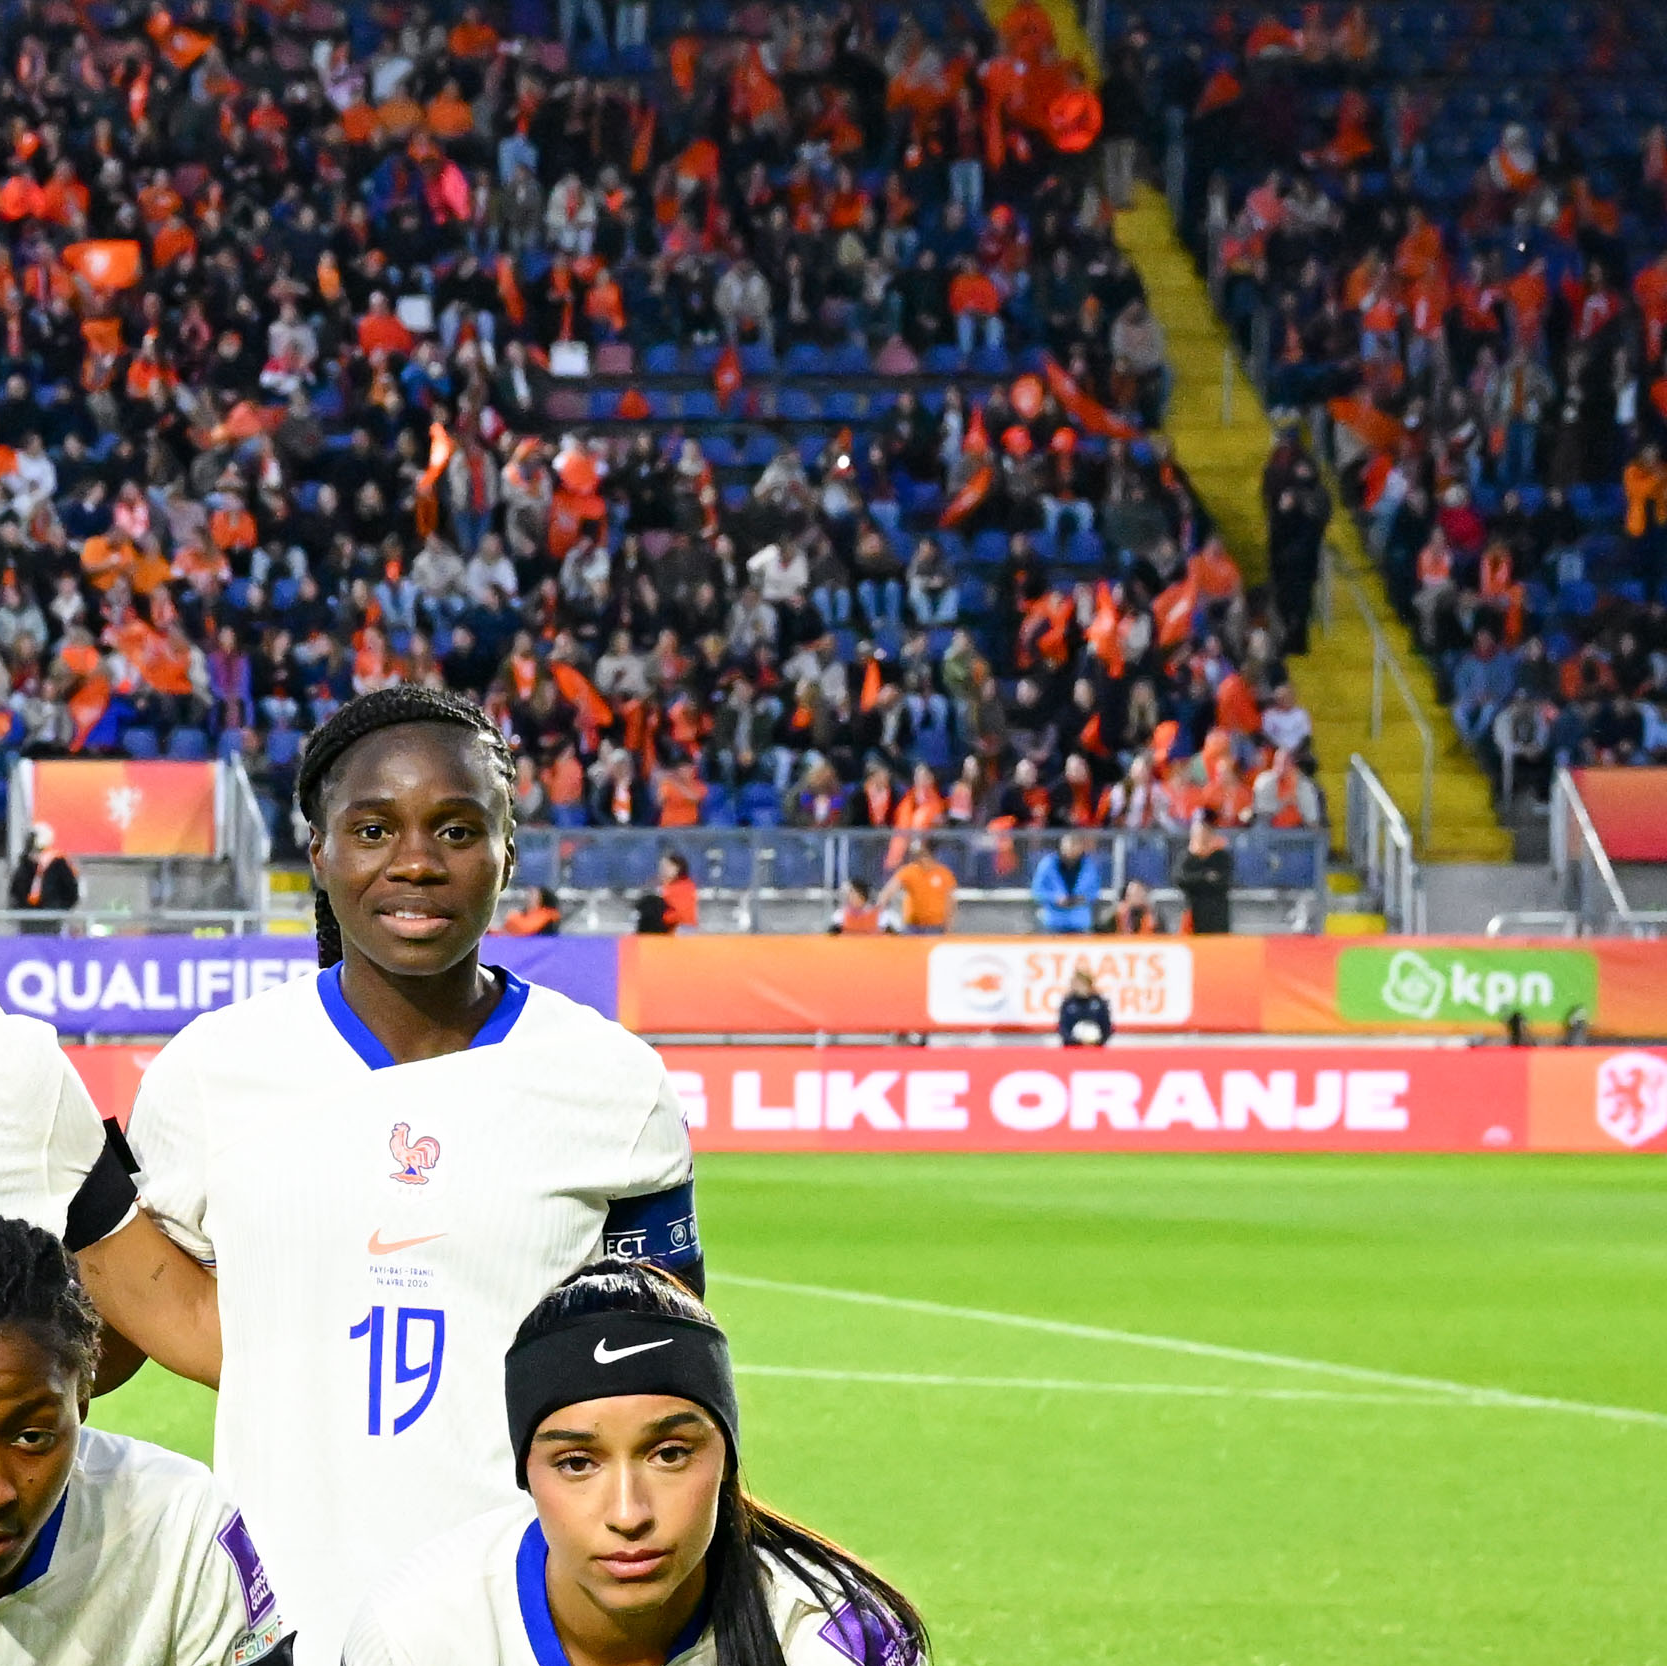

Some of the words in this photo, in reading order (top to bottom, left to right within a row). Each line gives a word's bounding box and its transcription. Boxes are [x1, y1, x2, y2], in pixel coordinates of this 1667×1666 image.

[1450, 961, 1554, 1016] kpn
[732, 1070, 970, 1131] LIKE
[990, 1070, 1409, 1131] ORANJE
[349, 1305, 445, 1436] 19
